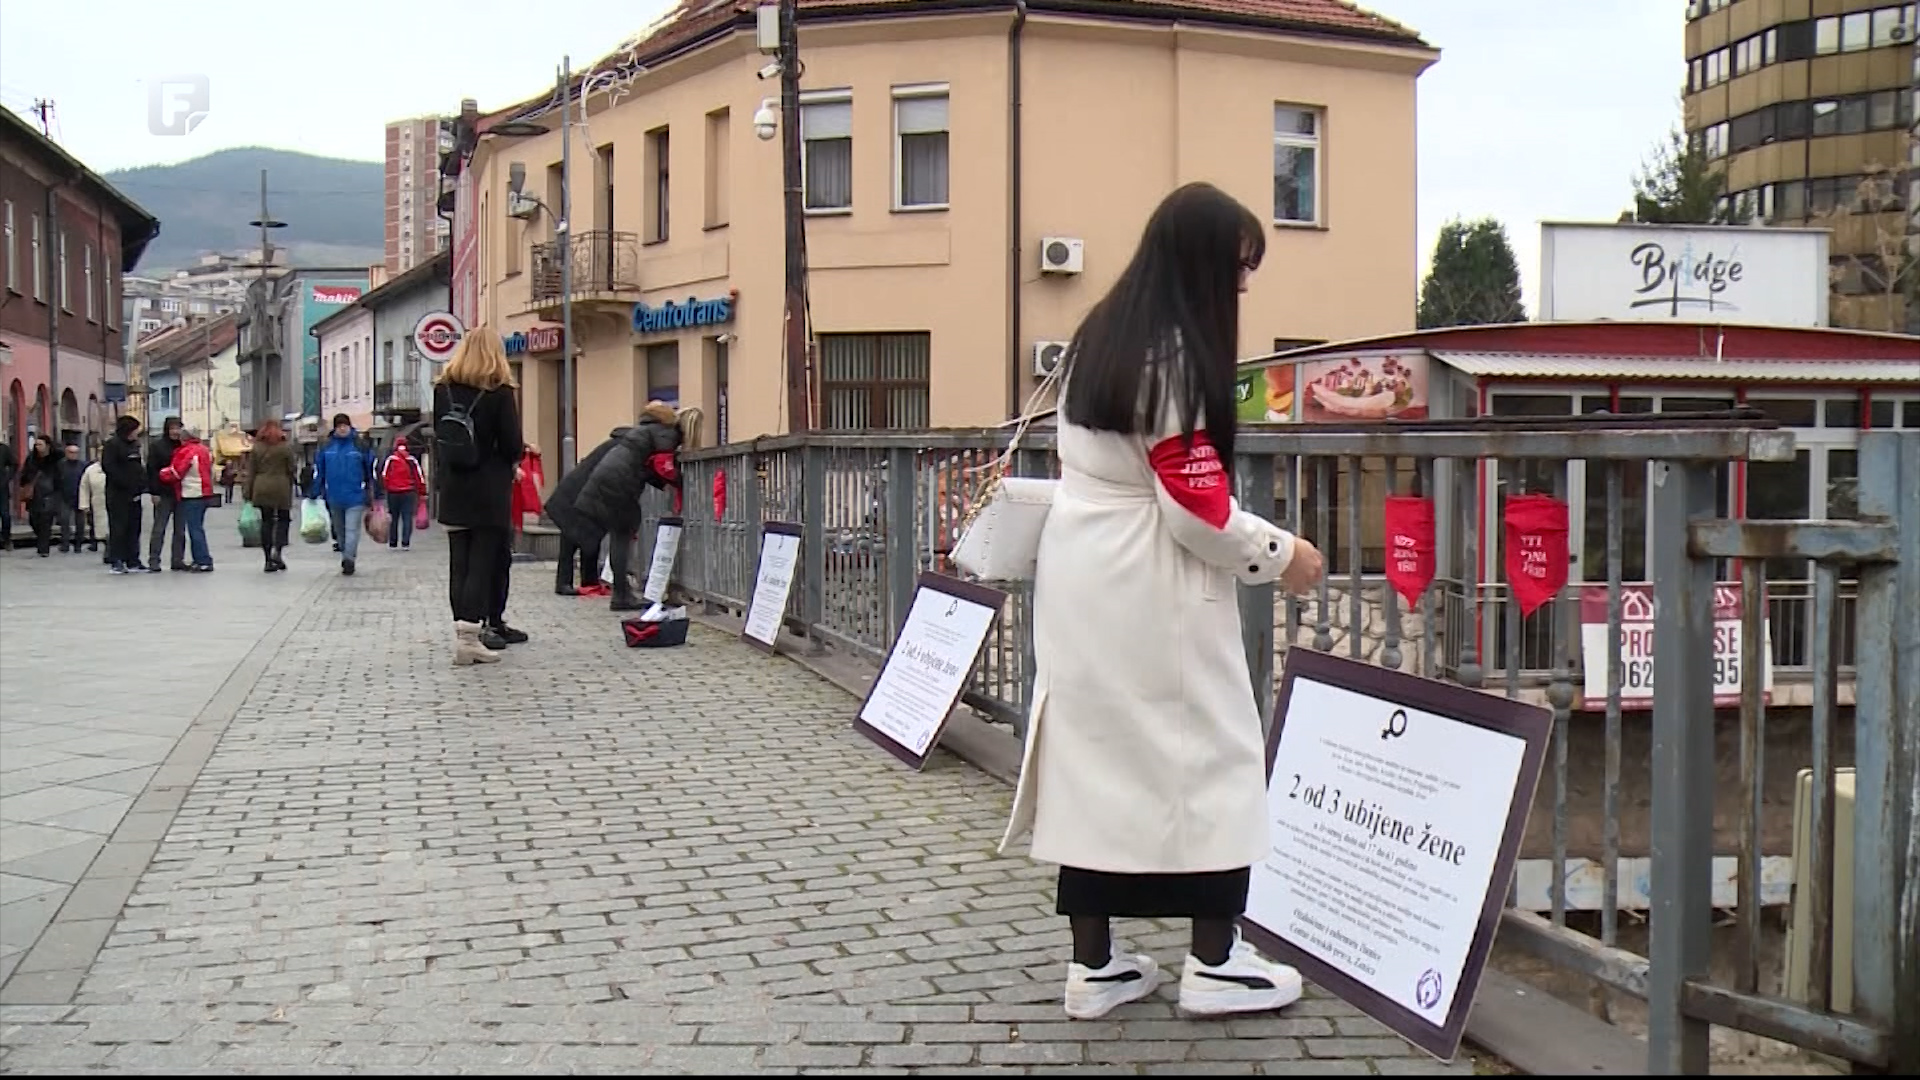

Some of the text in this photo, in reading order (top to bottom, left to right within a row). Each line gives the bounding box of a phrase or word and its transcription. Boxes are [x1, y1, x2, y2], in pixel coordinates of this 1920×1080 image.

[1629, 240, 1743, 315] Bridge
[633, 297, 731, 333] Centrotrans
[1714, 657, 1739, 685] 95
[1289, 774, 1466, 866] 2 od 3 ubijene žene
